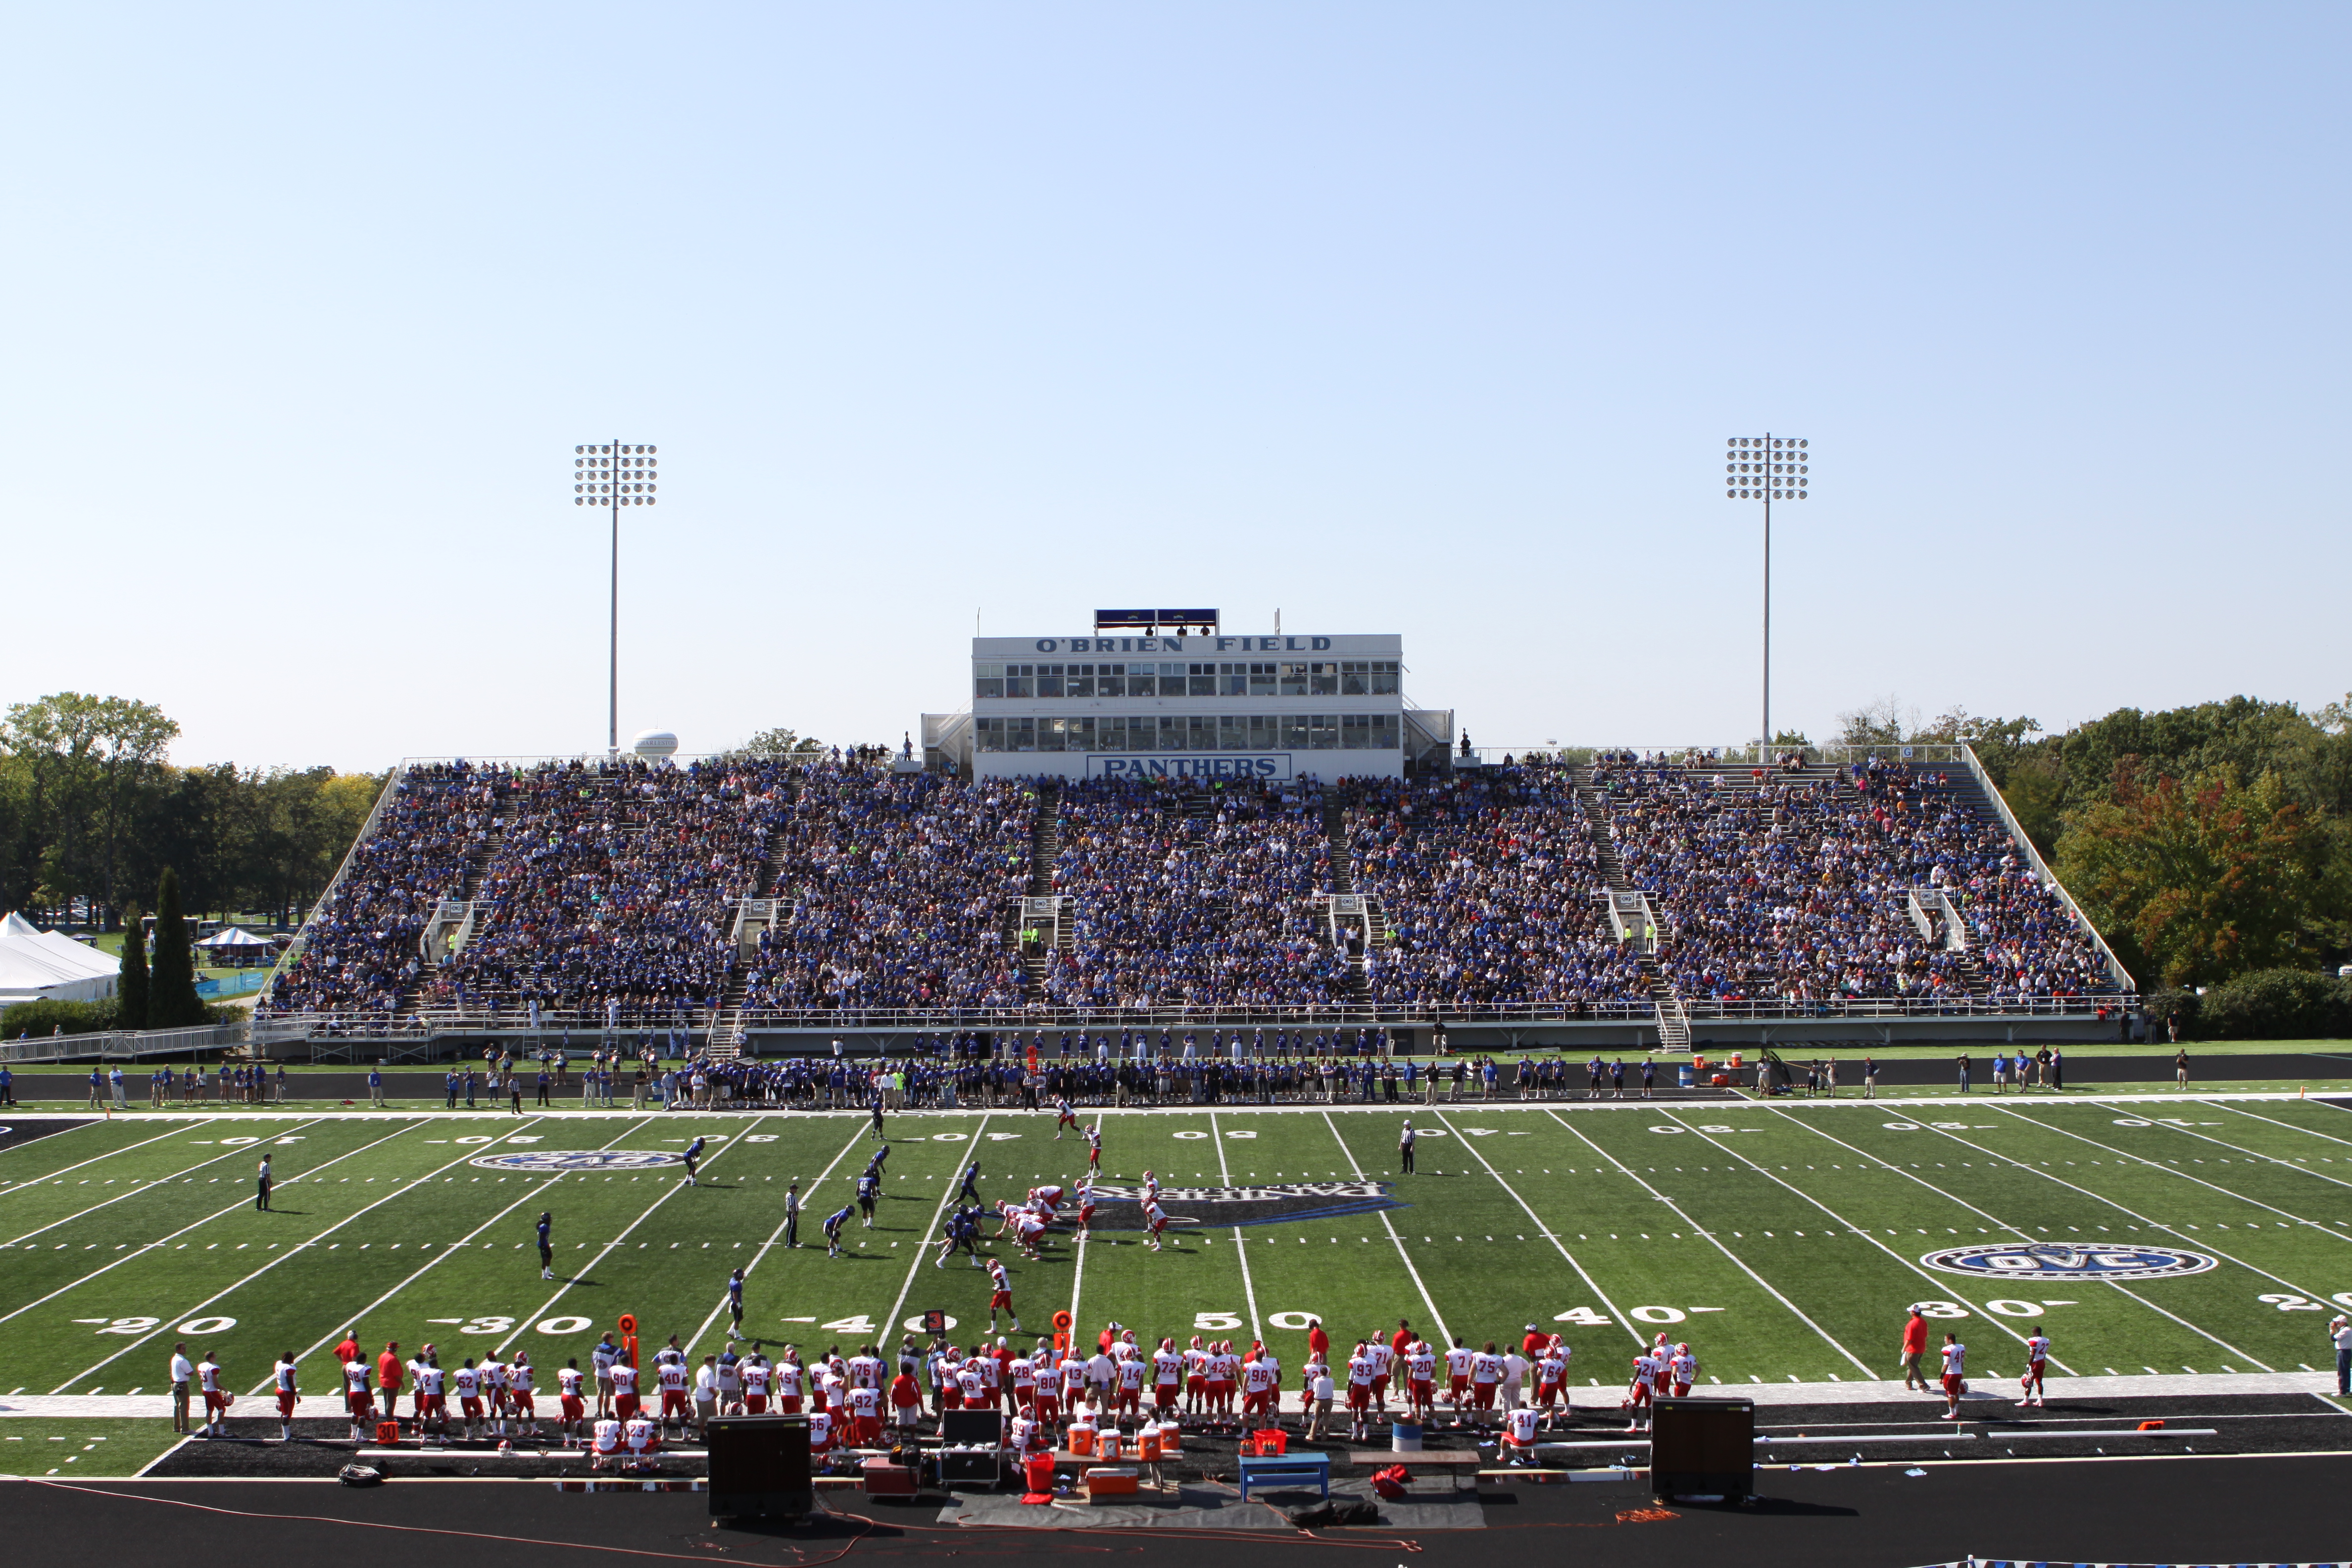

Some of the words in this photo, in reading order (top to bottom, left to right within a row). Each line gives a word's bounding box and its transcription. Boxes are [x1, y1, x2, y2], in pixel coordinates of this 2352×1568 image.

[1036, 638, 1183, 653] O'BRIEN
[1215, 636, 1331, 651] FIELD
[1904, 747, 1911, 756] G
[1104, 758, 1276, 779] PANTHERS
[1090, 1185, 1389, 1203] PANTHERS
[1984, 1253, 2149, 1270] OVC
[928, 1312, 941, 1328] 3
[2039, 1343, 2049, 1354] 27
[1376, 1352, 1387, 1364] 71
[1458, 1356, 1466, 1368] 7
[855, 1364, 871, 1376] 76
[1015, 1367, 1029, 1378] 28
[1162, 1362, 1177, 1373] 72
[1211, 1362, 1225, 1373] 42
[1357, 1364, 1372, 1376] 93
[1417, 1361, 1431, 1372] 20
[1479, 1360, 1495, 1373] 75
[1547, 1366, 1561, 1377] 64
[1641, 1364, 1655, 1377] 21
[1682, 1362, 1692, 1373] 31
[347, 1369, 361, 1382] 58
[614, 1373, 627, 1386] 90
[665, 1373, 680, 1384] 40
[747, 1373, 762, 1385] 35
[779, 1372, 792, 1384] 45
[1068, 1368, 1082, 1379] 13
[1127, 1368, 1140, 1380] 14
[1252, 1370, 1268, 1381] 98
[424, 1374, 432, 1386] 2
[458, 1376, 474, 1388] 52
[962, 1379, 975, 1391] 49
[1041, 1377, 1056, 1388] 80
[855, 1396, 872, 1408] 92
[1518, 1415, 1531, 1427] 41
[378, 1424, 395, 1440] 30
[598, 1424, 608, 1437] 11
[630, 1424, 645, 1437] 23
[1012, 1422, 1025, 1436] 39
